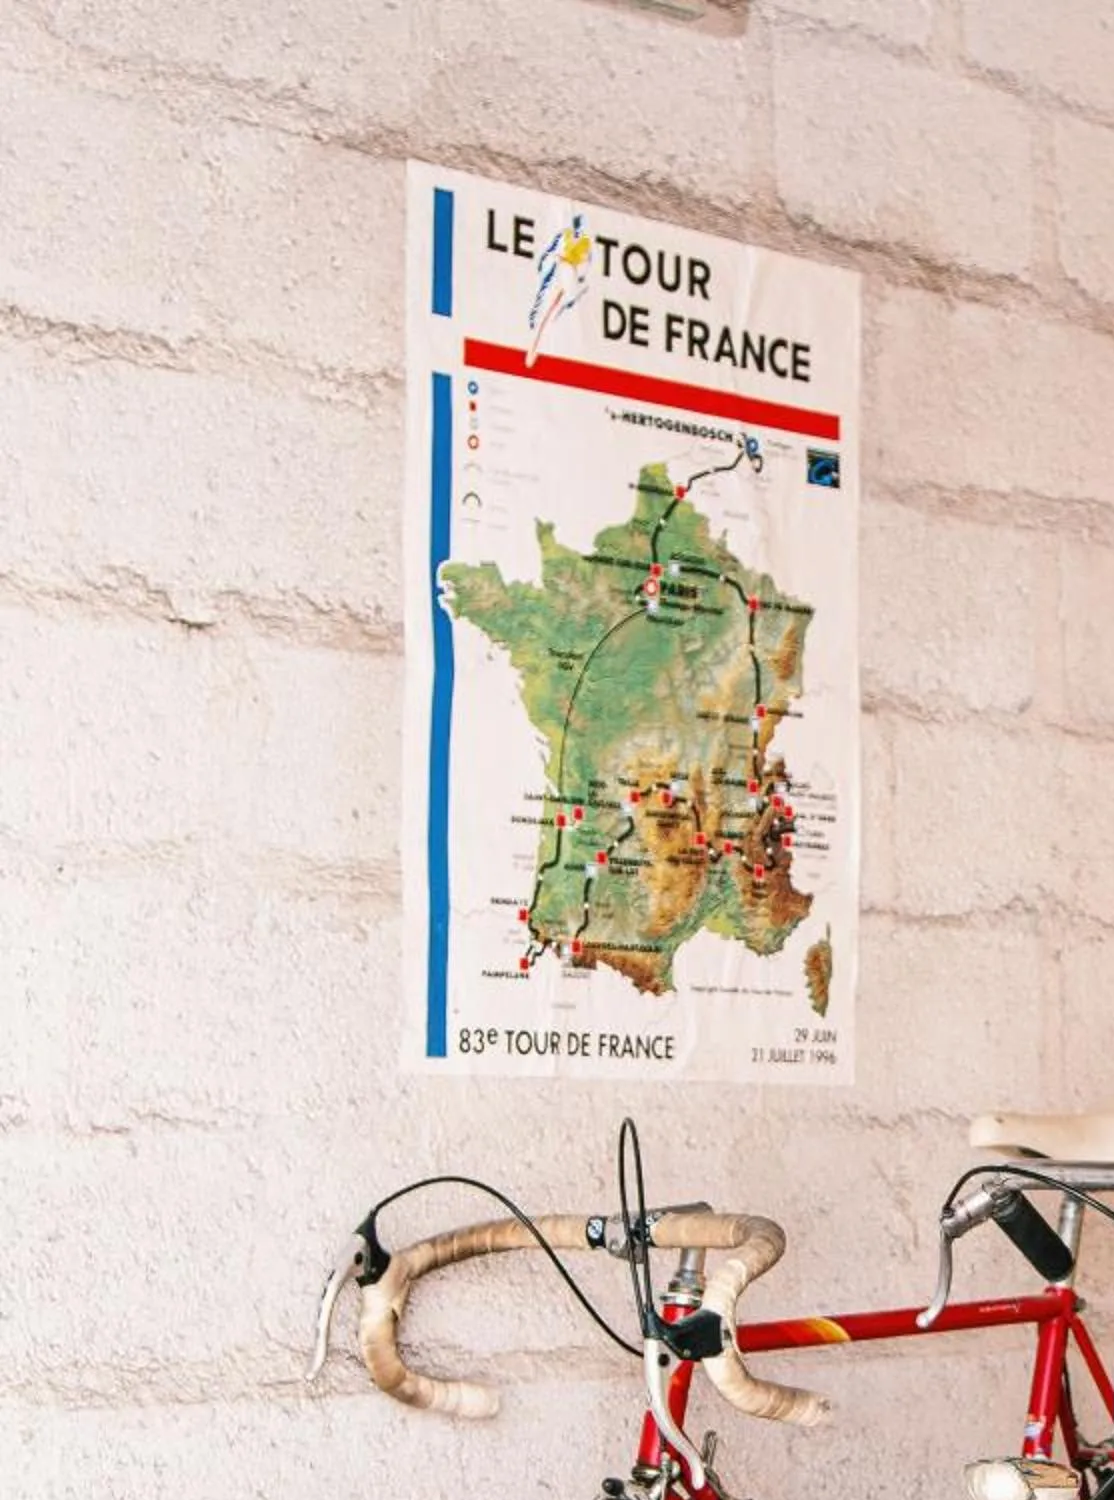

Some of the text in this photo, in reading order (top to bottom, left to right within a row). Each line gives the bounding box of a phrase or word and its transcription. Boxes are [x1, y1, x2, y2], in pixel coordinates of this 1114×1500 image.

[486, 208, 712, 300] LE TOUR
[602, 299, 811, 382] DE FRANCE
[504, 1029, 561, 1056] TOUR
[567, 1031, 591, 1057] DE
[598, 1033, 675, 1060] FRANCE
[794, 1027, 838, 1044] 29 JUIN
[767, 1048, 806, 1064] JUILLET
[810, 1049, 837, 1065] 1996
